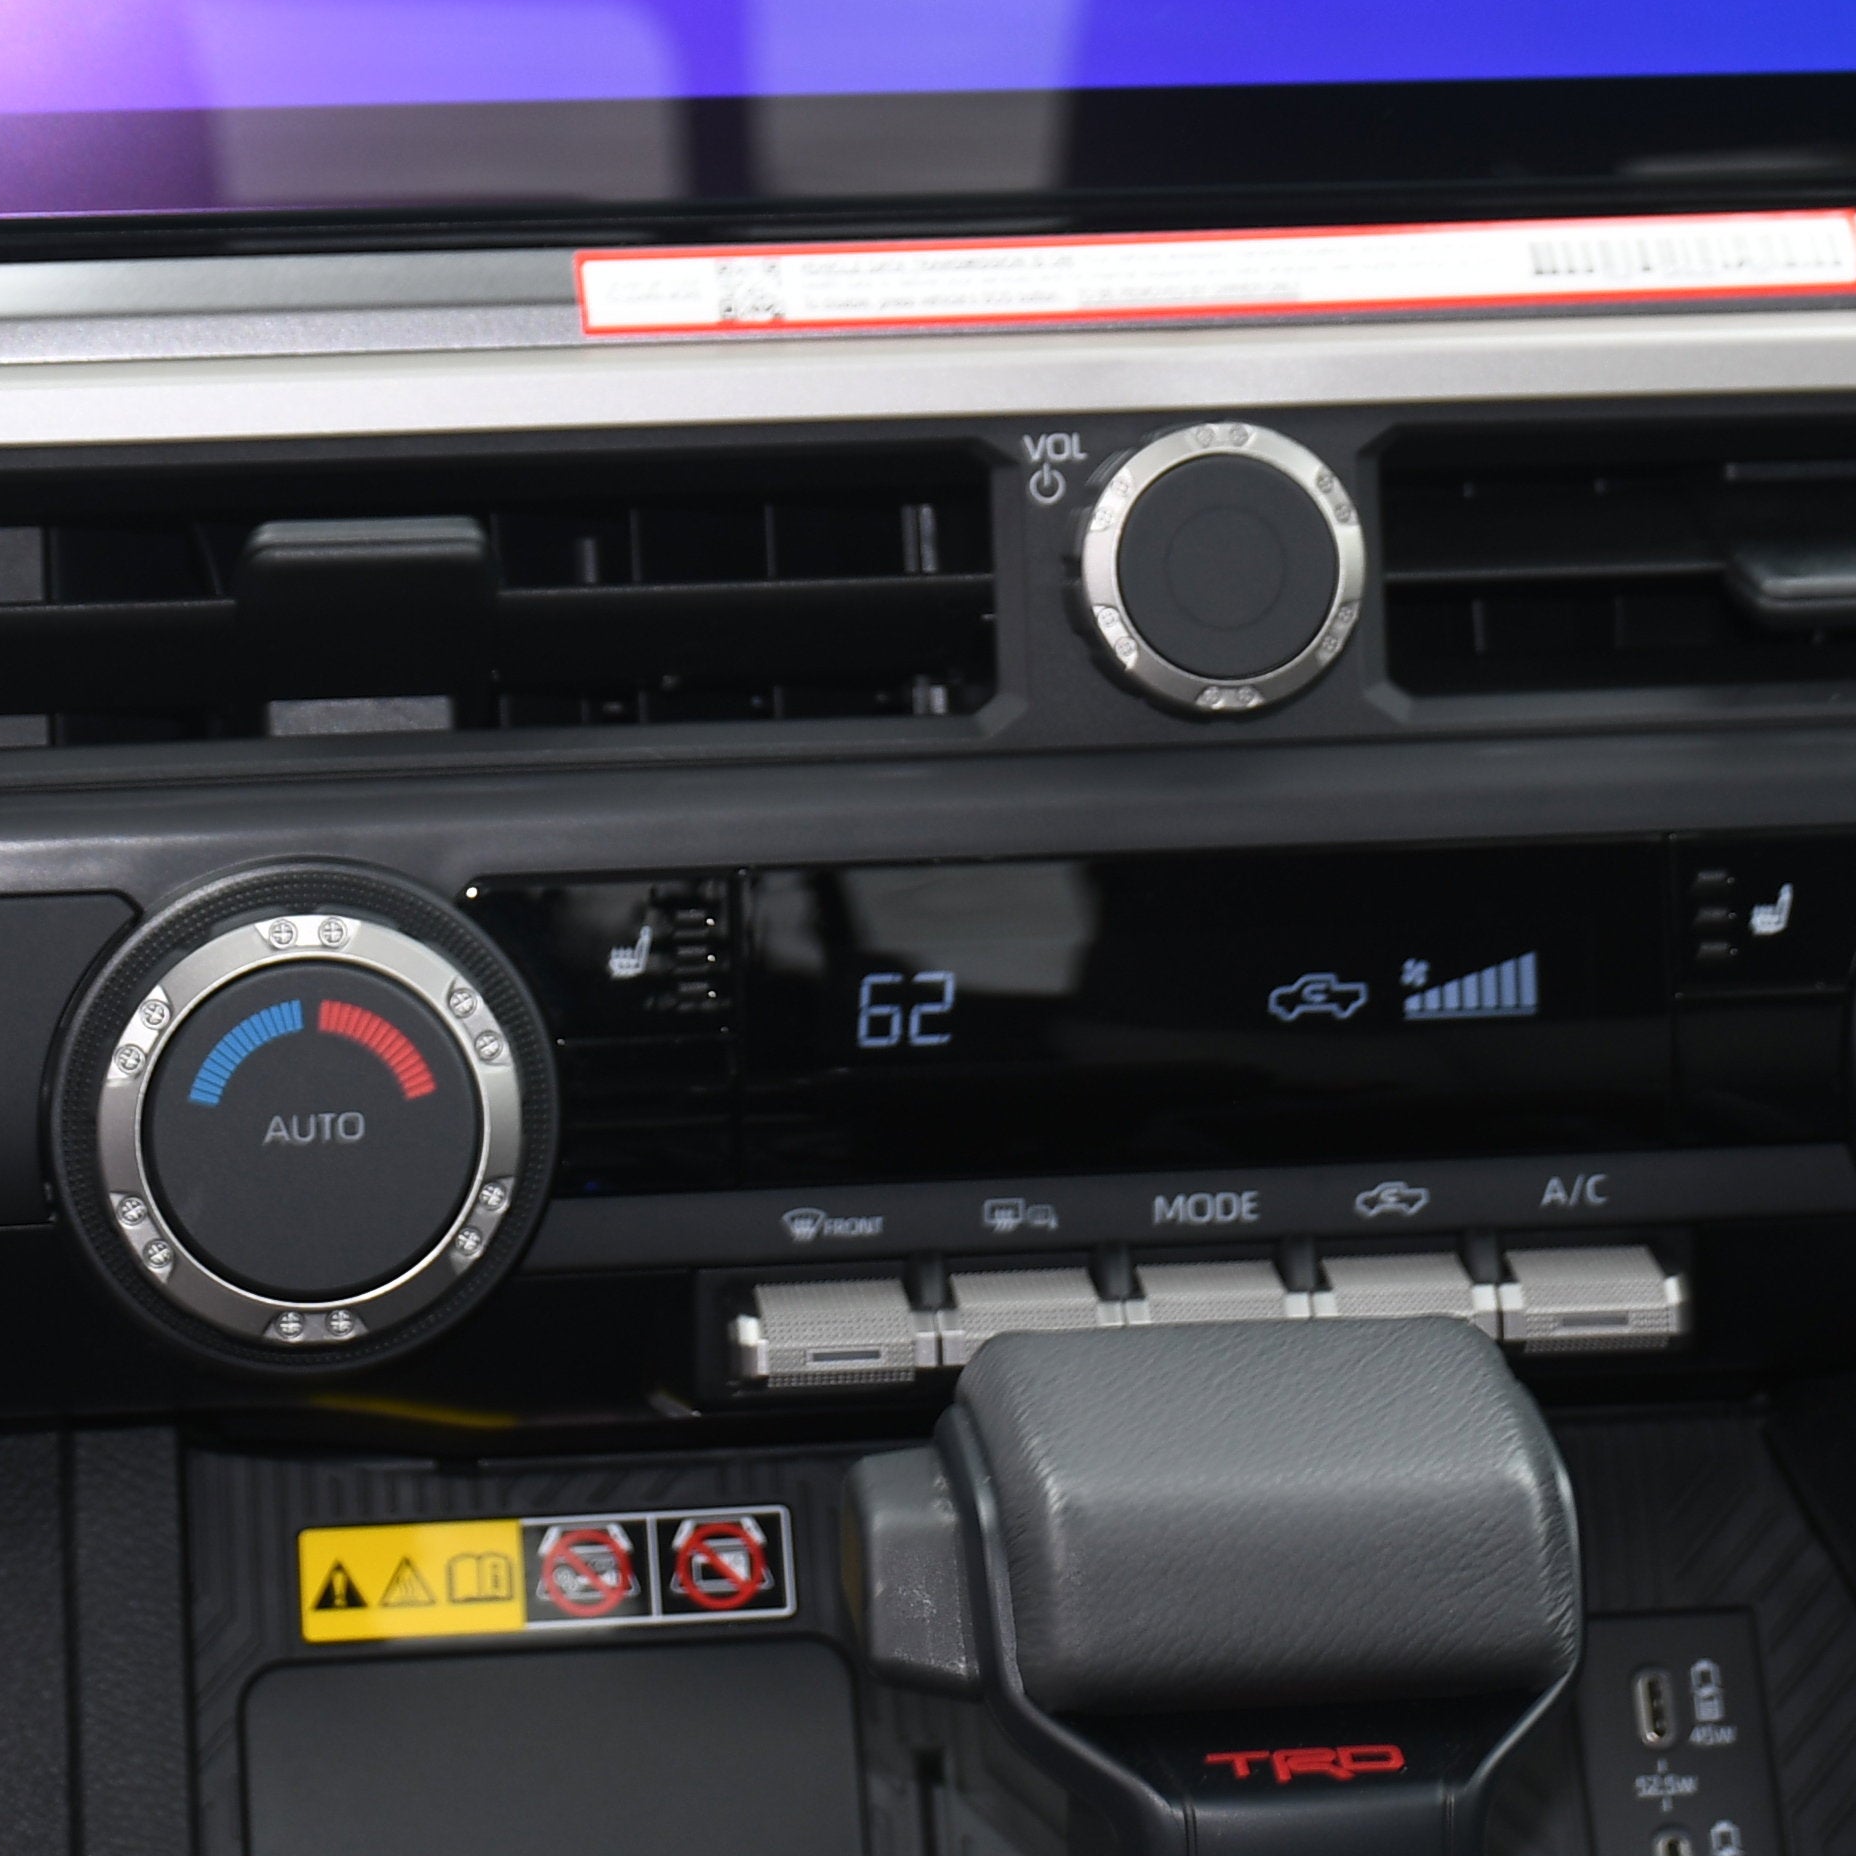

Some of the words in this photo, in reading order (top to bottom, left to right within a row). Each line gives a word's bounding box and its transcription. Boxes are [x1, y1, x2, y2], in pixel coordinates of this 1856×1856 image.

[1022, 432, 1087, 463] VOL
[857, 971, 956, 1049] 62
[262, 1110, 366, 1145] AUTO
[1540, 1173, 1610, 1208] A/C
[823, 1215, 884, 1237] FRONT
[1153, 1190, 1261, 1227] MODE
[1204, 1743, 1406, 1785] TRD
